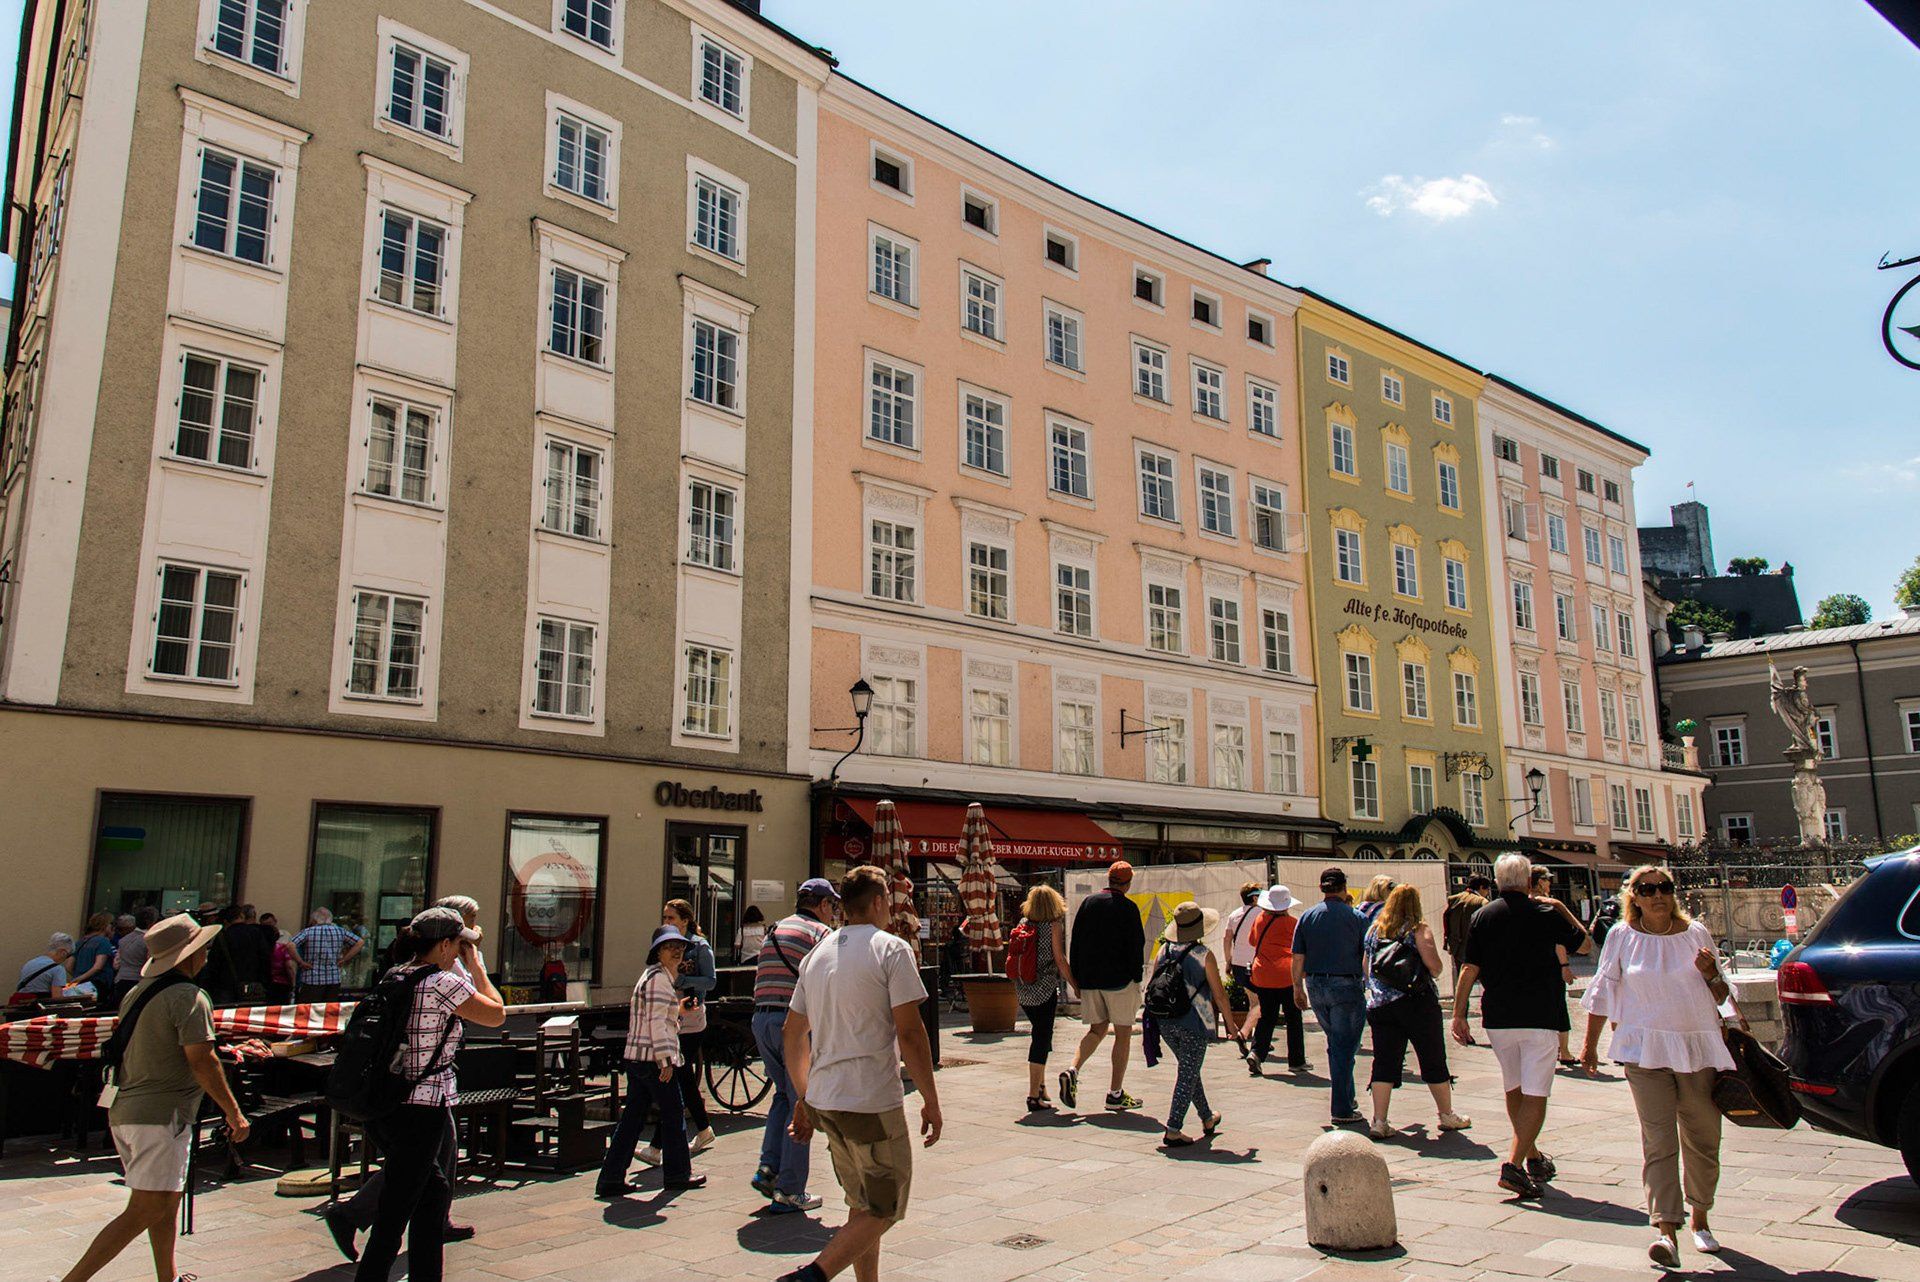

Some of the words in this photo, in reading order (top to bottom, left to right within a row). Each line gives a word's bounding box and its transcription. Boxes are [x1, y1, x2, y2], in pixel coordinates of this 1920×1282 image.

[1343, 598, 1372, 617] Alte
[1393, 607, 1468, 639] Hofapotheke
[655, 781, 763, 812] Oberbank
[932, 842, 948, 853] DIE
[991, 844, 1012, 854] EBER
